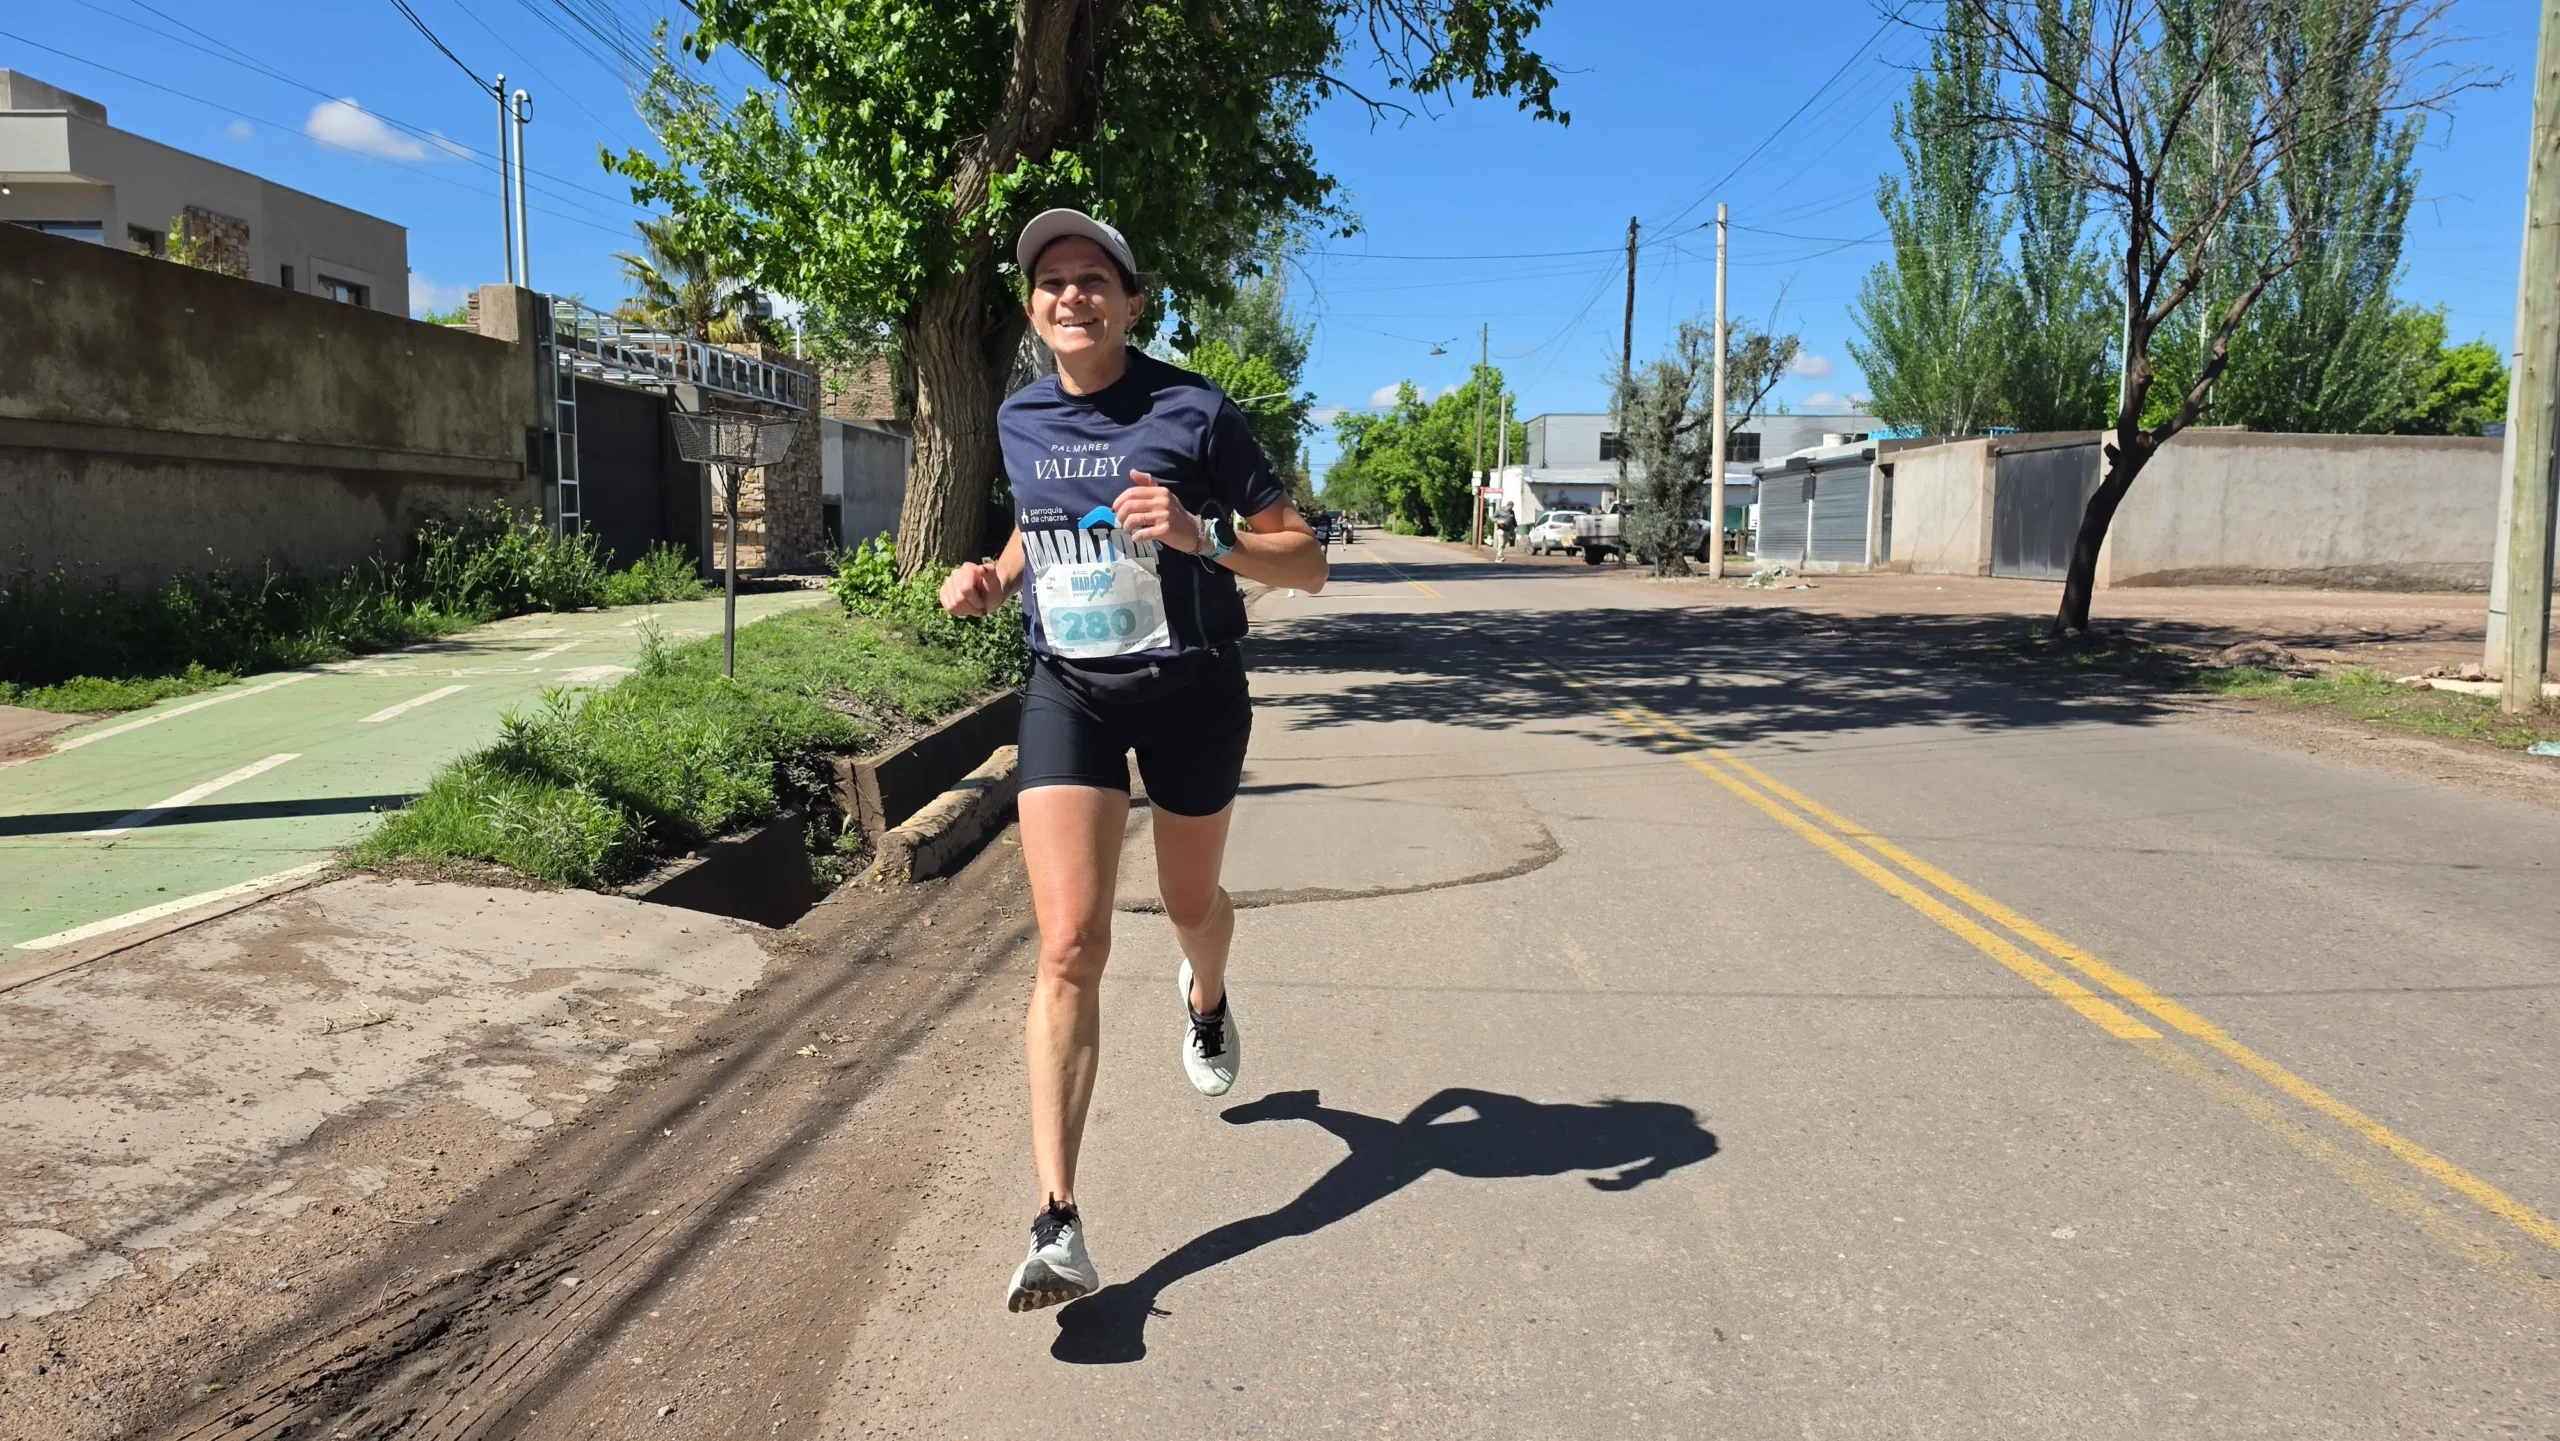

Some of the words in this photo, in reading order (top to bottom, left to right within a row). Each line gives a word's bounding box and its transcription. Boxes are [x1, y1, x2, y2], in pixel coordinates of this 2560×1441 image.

[1050, 443, 1110, 452] PALMARES
[1035, 455, 1126, 480] VALLEY
[1030, 506, 1063, 516] parroquia
[1031, 515, 1040, 523] de
[1040, 514, 1068, 523] chacras
[1061, 608, 1136, 641] 280
